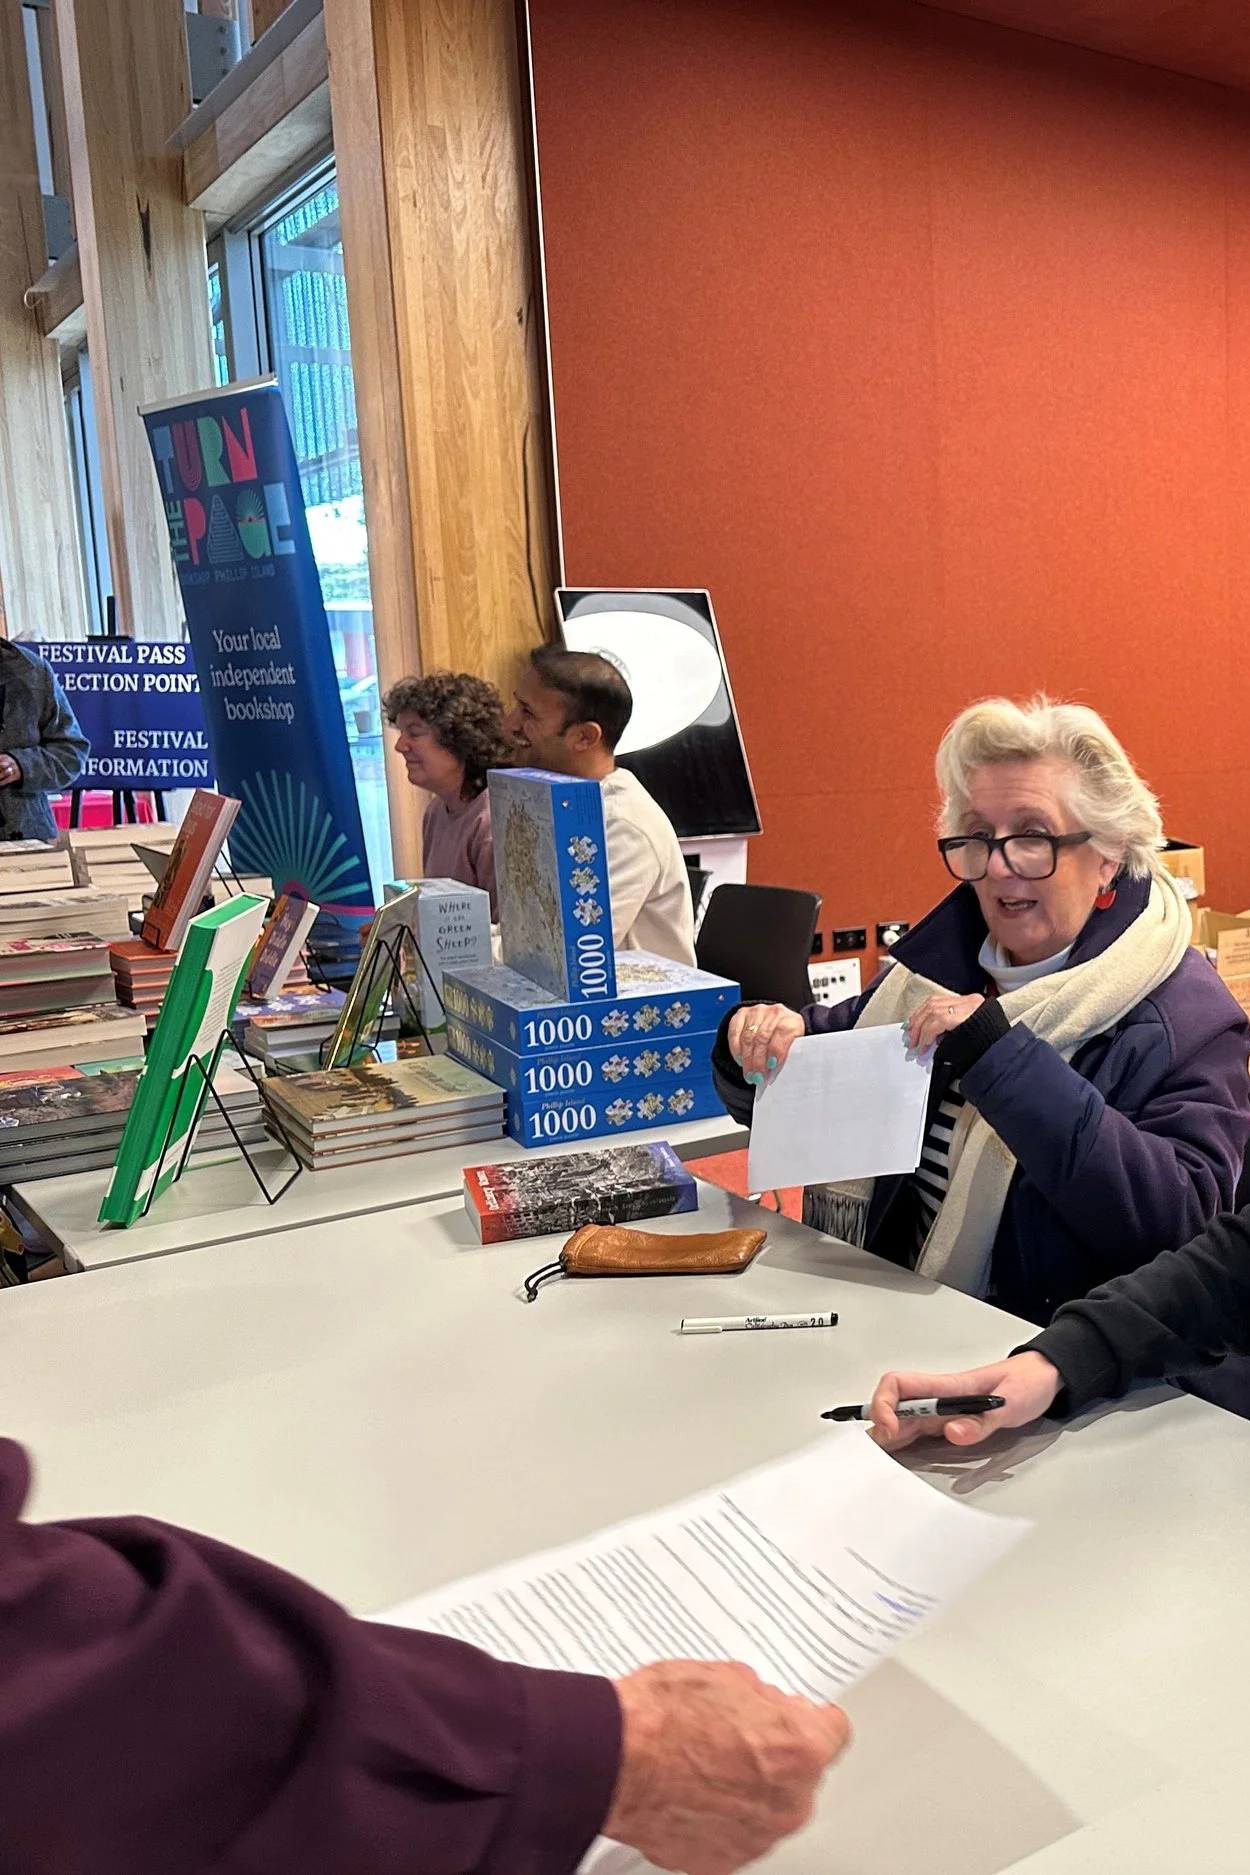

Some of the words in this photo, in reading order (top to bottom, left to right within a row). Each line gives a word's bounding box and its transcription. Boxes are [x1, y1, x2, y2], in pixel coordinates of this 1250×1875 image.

[152, 407, 258, 494] TURN
[212, 629, 250, 653] Your
[250, 624, 282, 651] local
[38, 645, 133, 664] FESTIVAL
[137, 645, 186, 665] PASS
[210, 660, 296, 691] independent
[224, 696, 295, 725] bookshop
[113, 730, 208, 749] FESTIVAL
[81, 758, 208, 777] NFORMATION
[439, 901, 471, 914] WHERE
[438, 925, 472, 934] GREEN
[577, 934, 608, 999] 1000
[524, 1014, 593, 1048] 1000
[524, 1060, 593, 1094] 1000
[541, 1101, 564, 1111] Phillip
[529, 1104, 597, 1139] 1000
